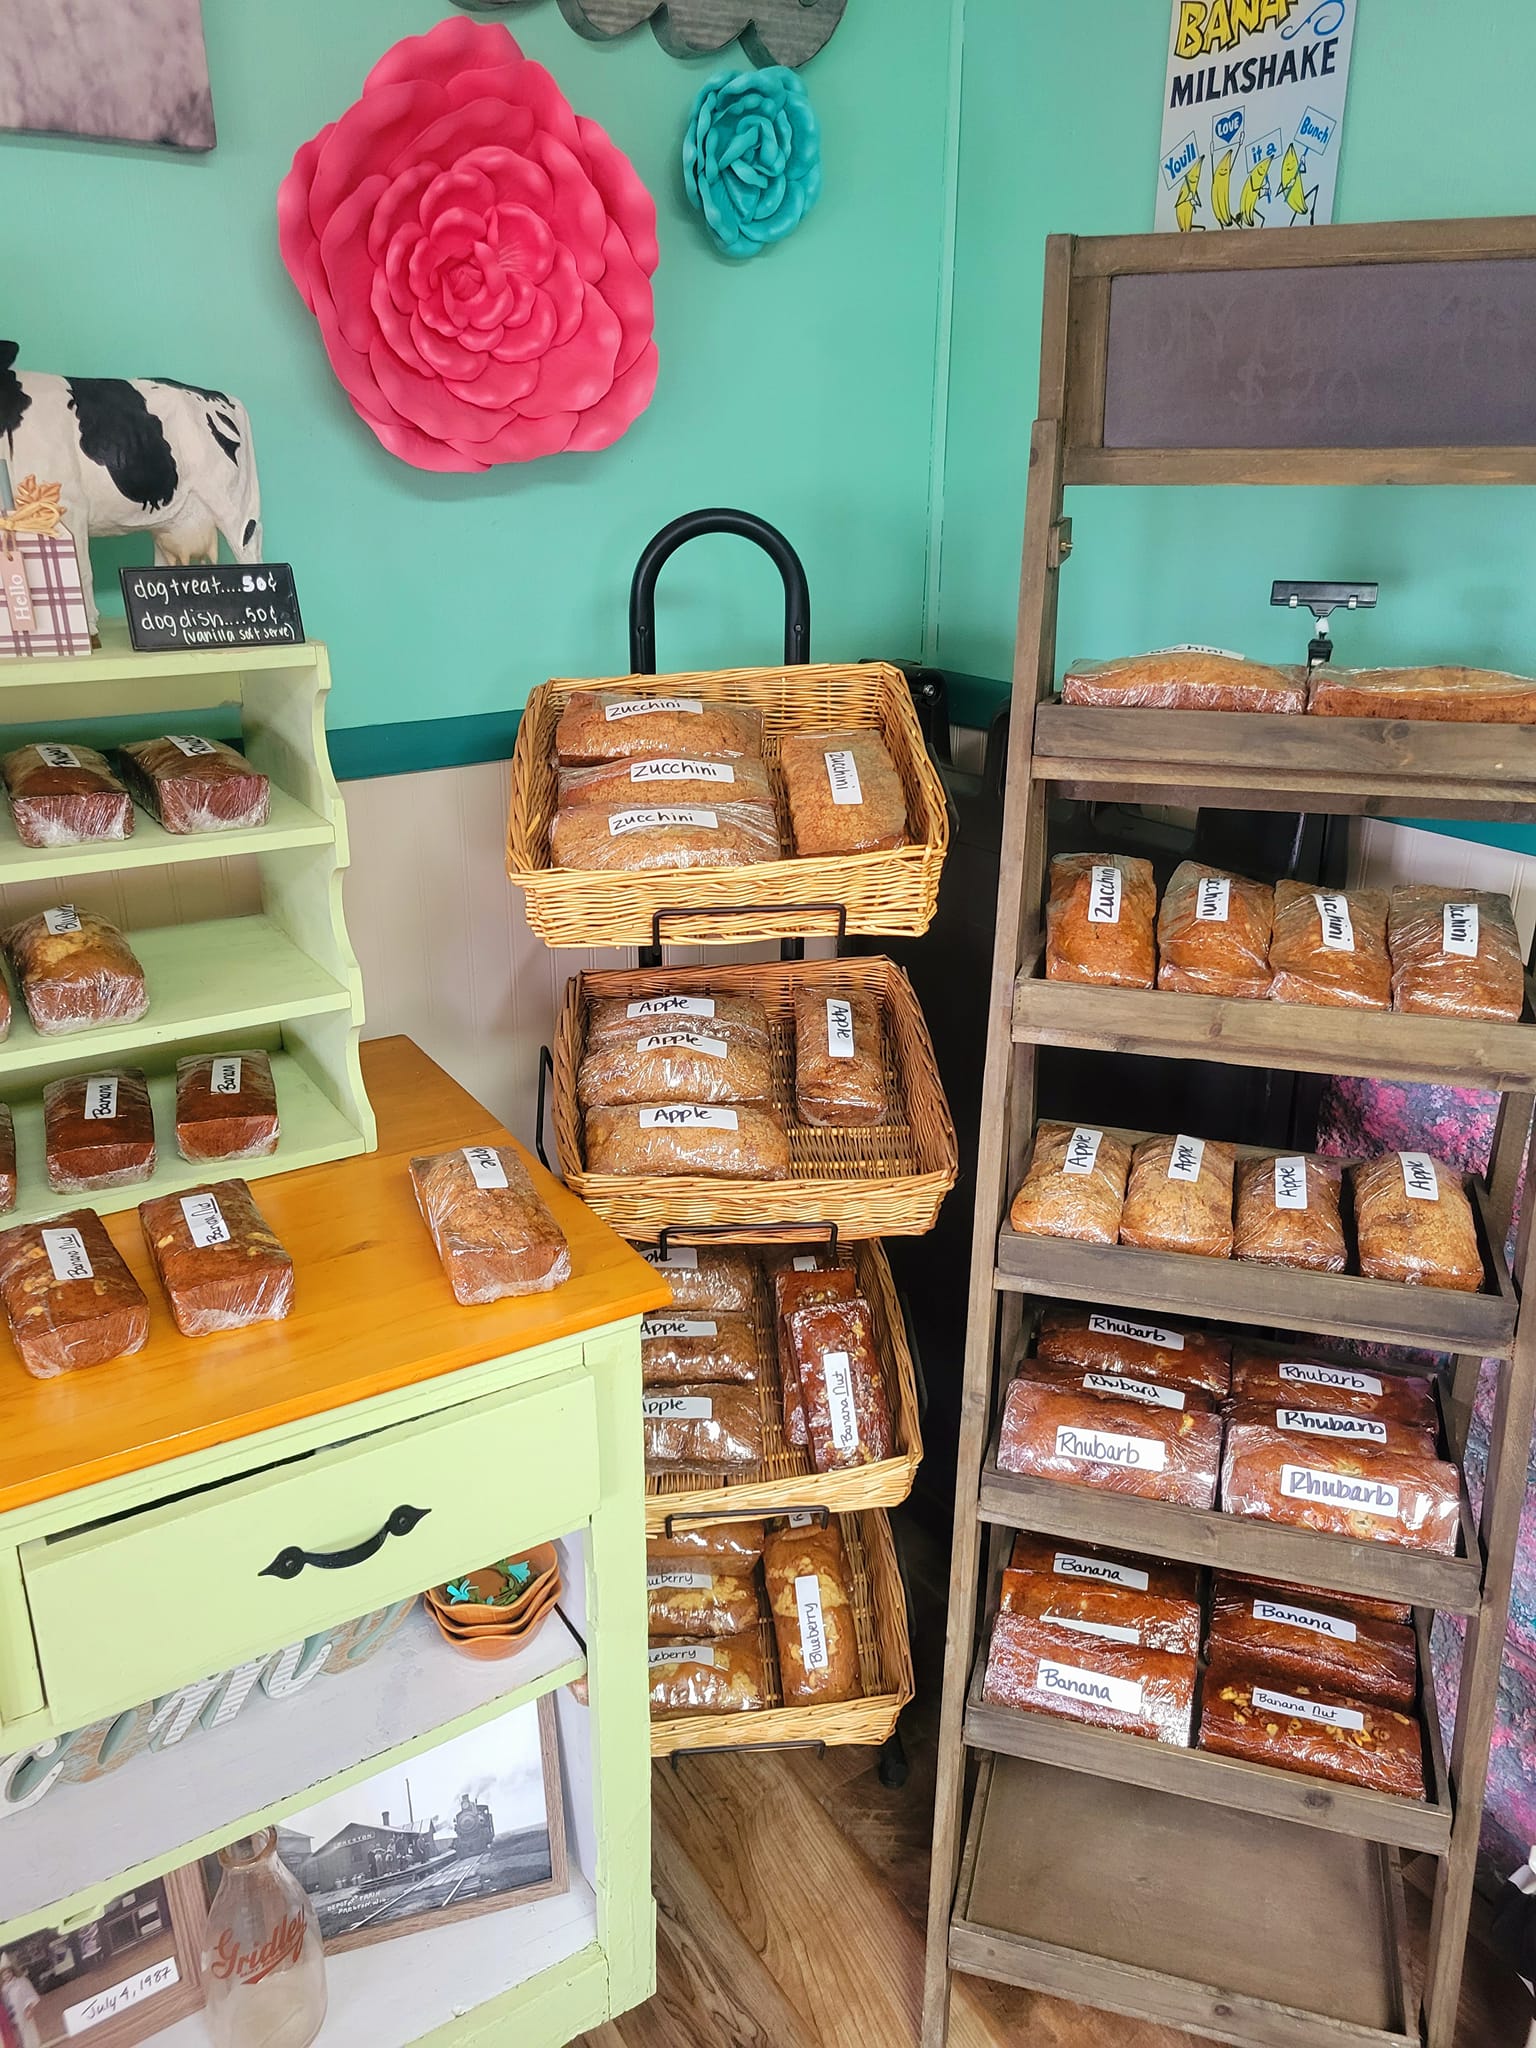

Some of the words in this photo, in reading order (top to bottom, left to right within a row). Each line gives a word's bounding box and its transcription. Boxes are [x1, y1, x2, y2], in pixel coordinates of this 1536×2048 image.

[1170, 37, 1339, 109] MILKSHAKE
[1217, 116, 1239, 135] LOVE
[1299, 116, 1329, 144] Bunch
[1251, 146, 1263, 164] it
[1266, 142, 1278, 156] a
[8, 574, 31, 620] Hello
[134, 578, 168, 604] dog
[141, 611, 177, 638] dog
[238, 627, 261, 641] soft
[608, 699, 681, 718] Zucchini
[633, 761, 717, 778] Zucchini
[612, 811, 694, 831] Zucchini
[639, 996, 690, 1013] Apple
[831, 1005, 851, 1039] Apple
[647, 1033, 702, 1047] Apple
[92, 1083, 113, 1119] Banana
[654, 1106, 712, 1124] Apple
[1067, 1134, 1094, 1168] Apple
[1174, 1144, 1197, 1173] Apple
[1278, 1166, 1303, 1198] Apple
[1405, 1160, 1433, 1192] Apple
[1091, 1316, 1166, 1342] Rhubarb
[1282, 1365, 1365, 1389] Rhubarb
[840, 1397, 853, 1446] Banana
[1284, 1411, 1385, 1436] Rhubarb
[1058, 1431, 1140, 1465] Rhubarb
[1289, 1471, 1394, 1507] Rhubarb
[647, 1572, 693, 1586] ueberry
[1054, 1556, 1124, 1582] Banana
[1254, 1604, 1336, 1635] Banana
[804, 1602, 823, 1667] Blueberry
[648, 1649, 696, 1663] ueberry
[1040, 1667, 1113, 1703] Banana
[1256, 1692, 1306, 1712] Banana
[211, 1903, 307, 1981] Gridley
[81, 1996, 117, 2019] July
[140, 1966, 172, 1990] 1987
